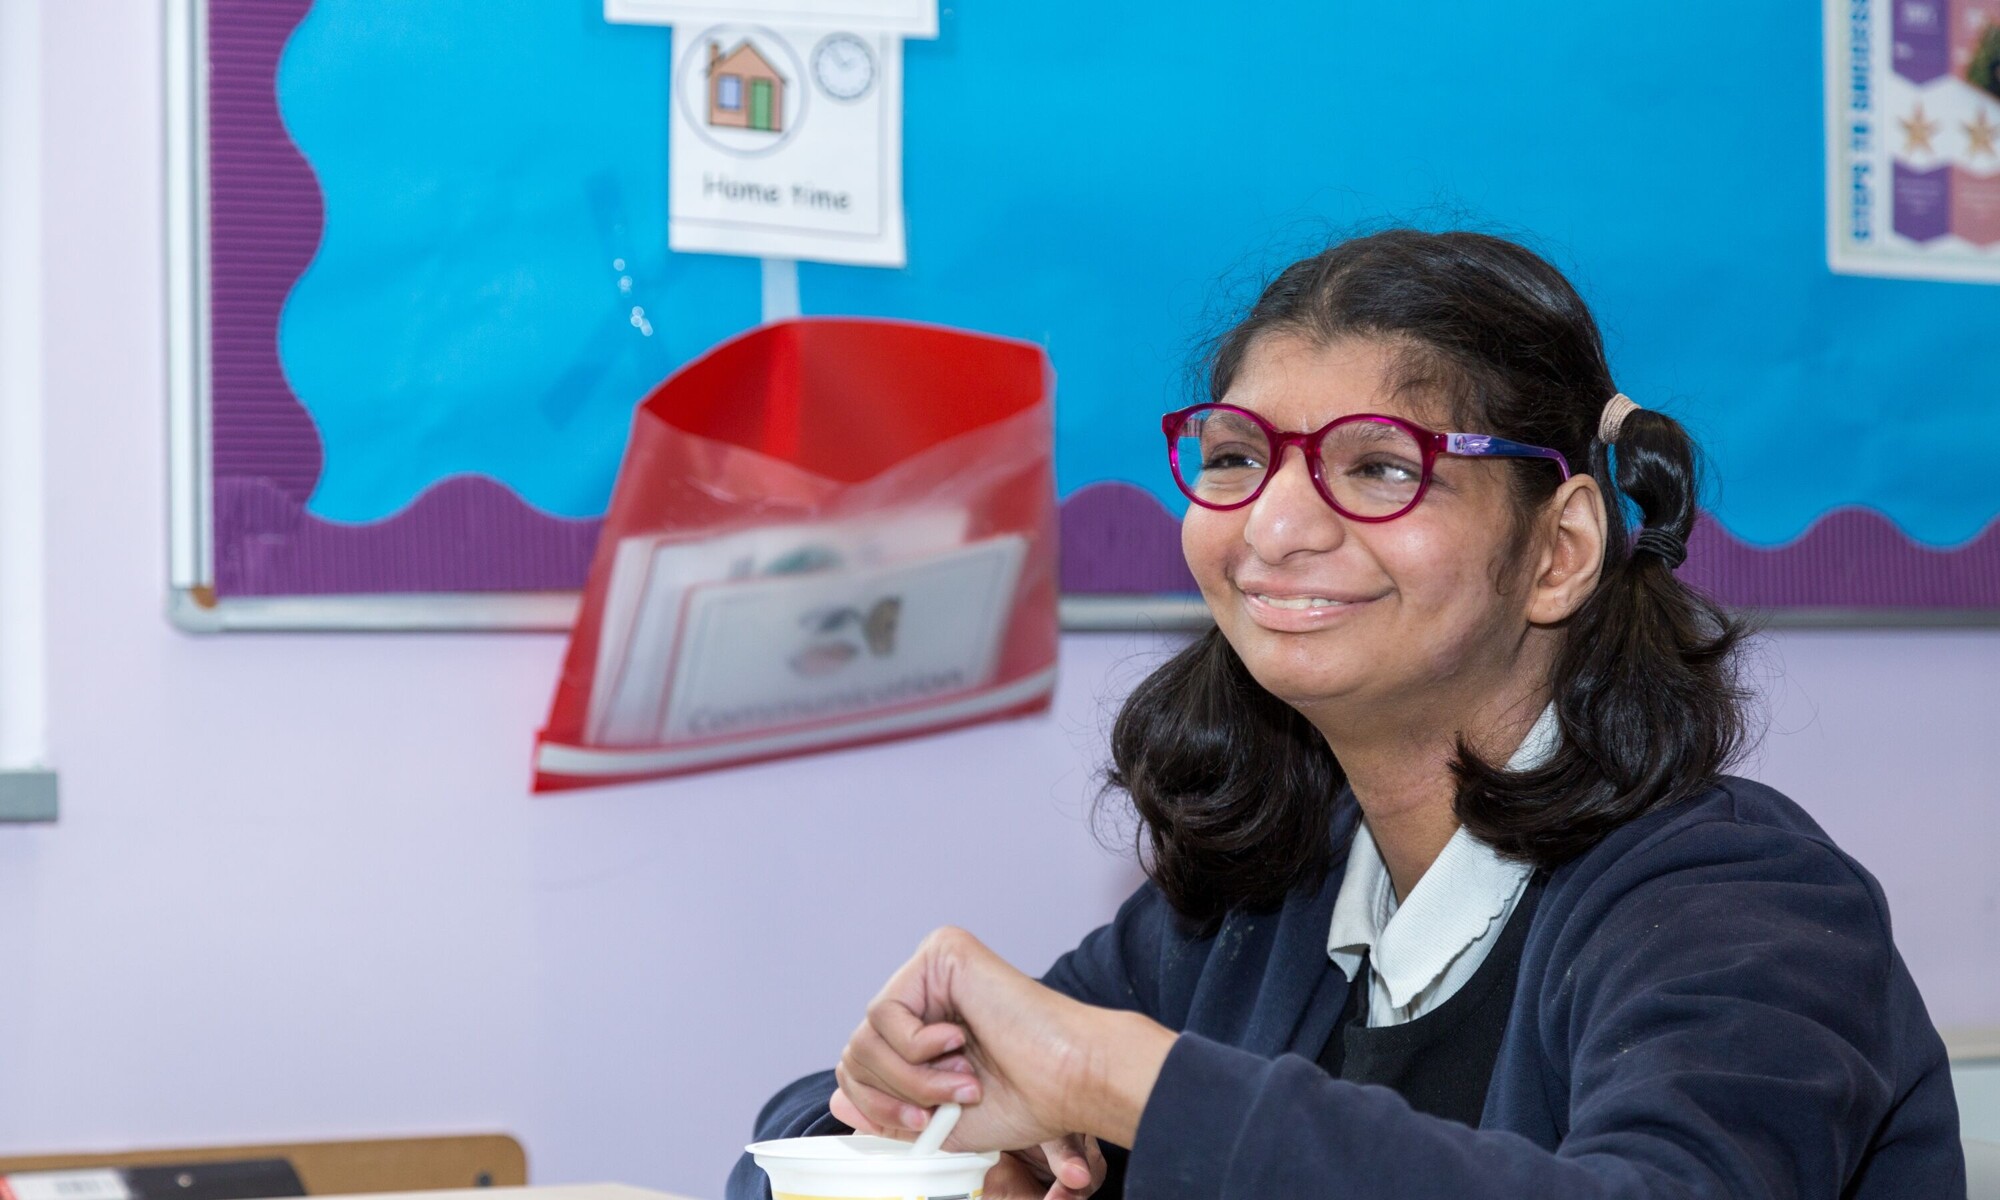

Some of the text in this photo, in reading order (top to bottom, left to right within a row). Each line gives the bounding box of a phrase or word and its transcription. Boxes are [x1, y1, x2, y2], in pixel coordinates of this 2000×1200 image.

[1852, 123, 1870, 149] TO
[702, 170, 779, 204] Home
[1852, 163, 1870, 241] STEPS
